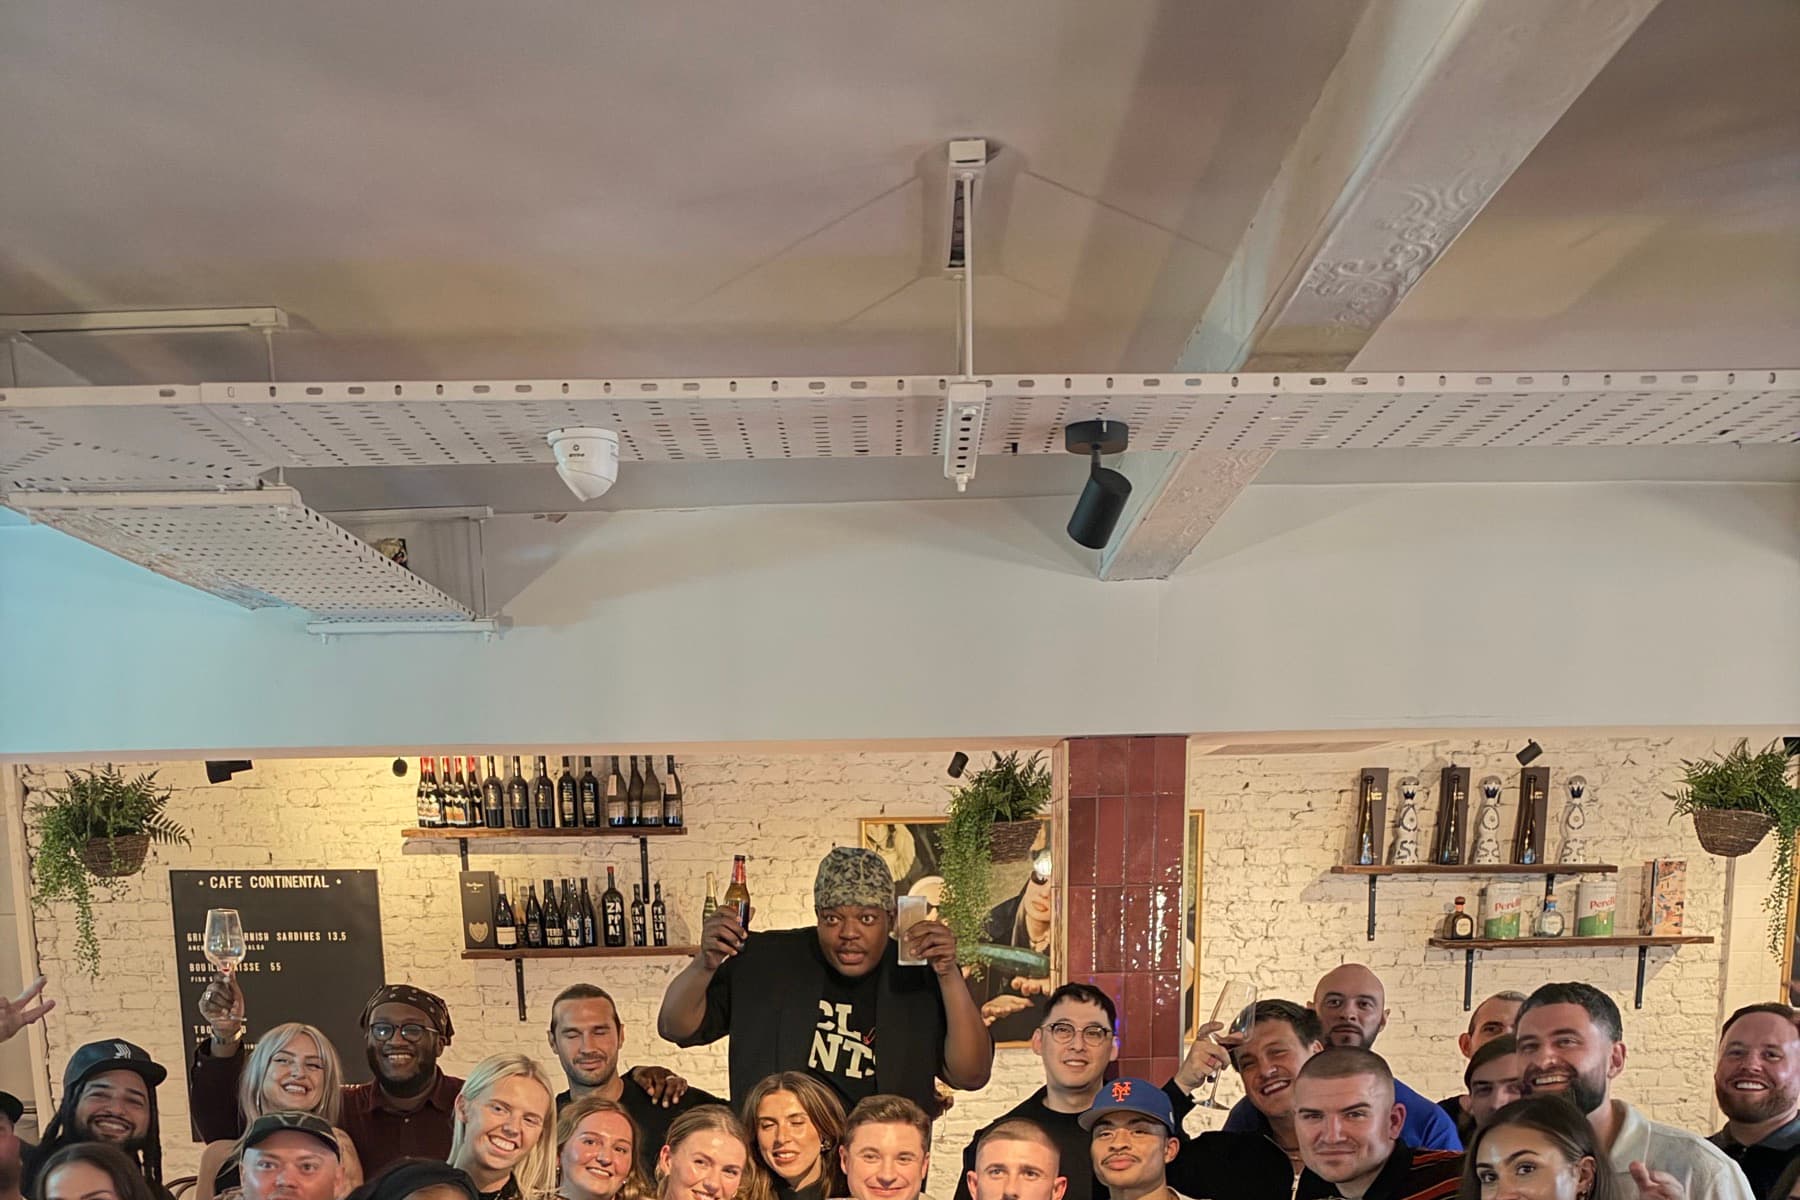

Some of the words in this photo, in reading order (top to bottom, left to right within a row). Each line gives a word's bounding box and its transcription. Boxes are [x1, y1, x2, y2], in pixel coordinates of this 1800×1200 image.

[209, 875, 243, 889] CAFE
[250, 875, 330, 888] CONTINENTAL
[276, 931, 321, 941] SARDINES
[328, 931, 347, 941] 13.5
